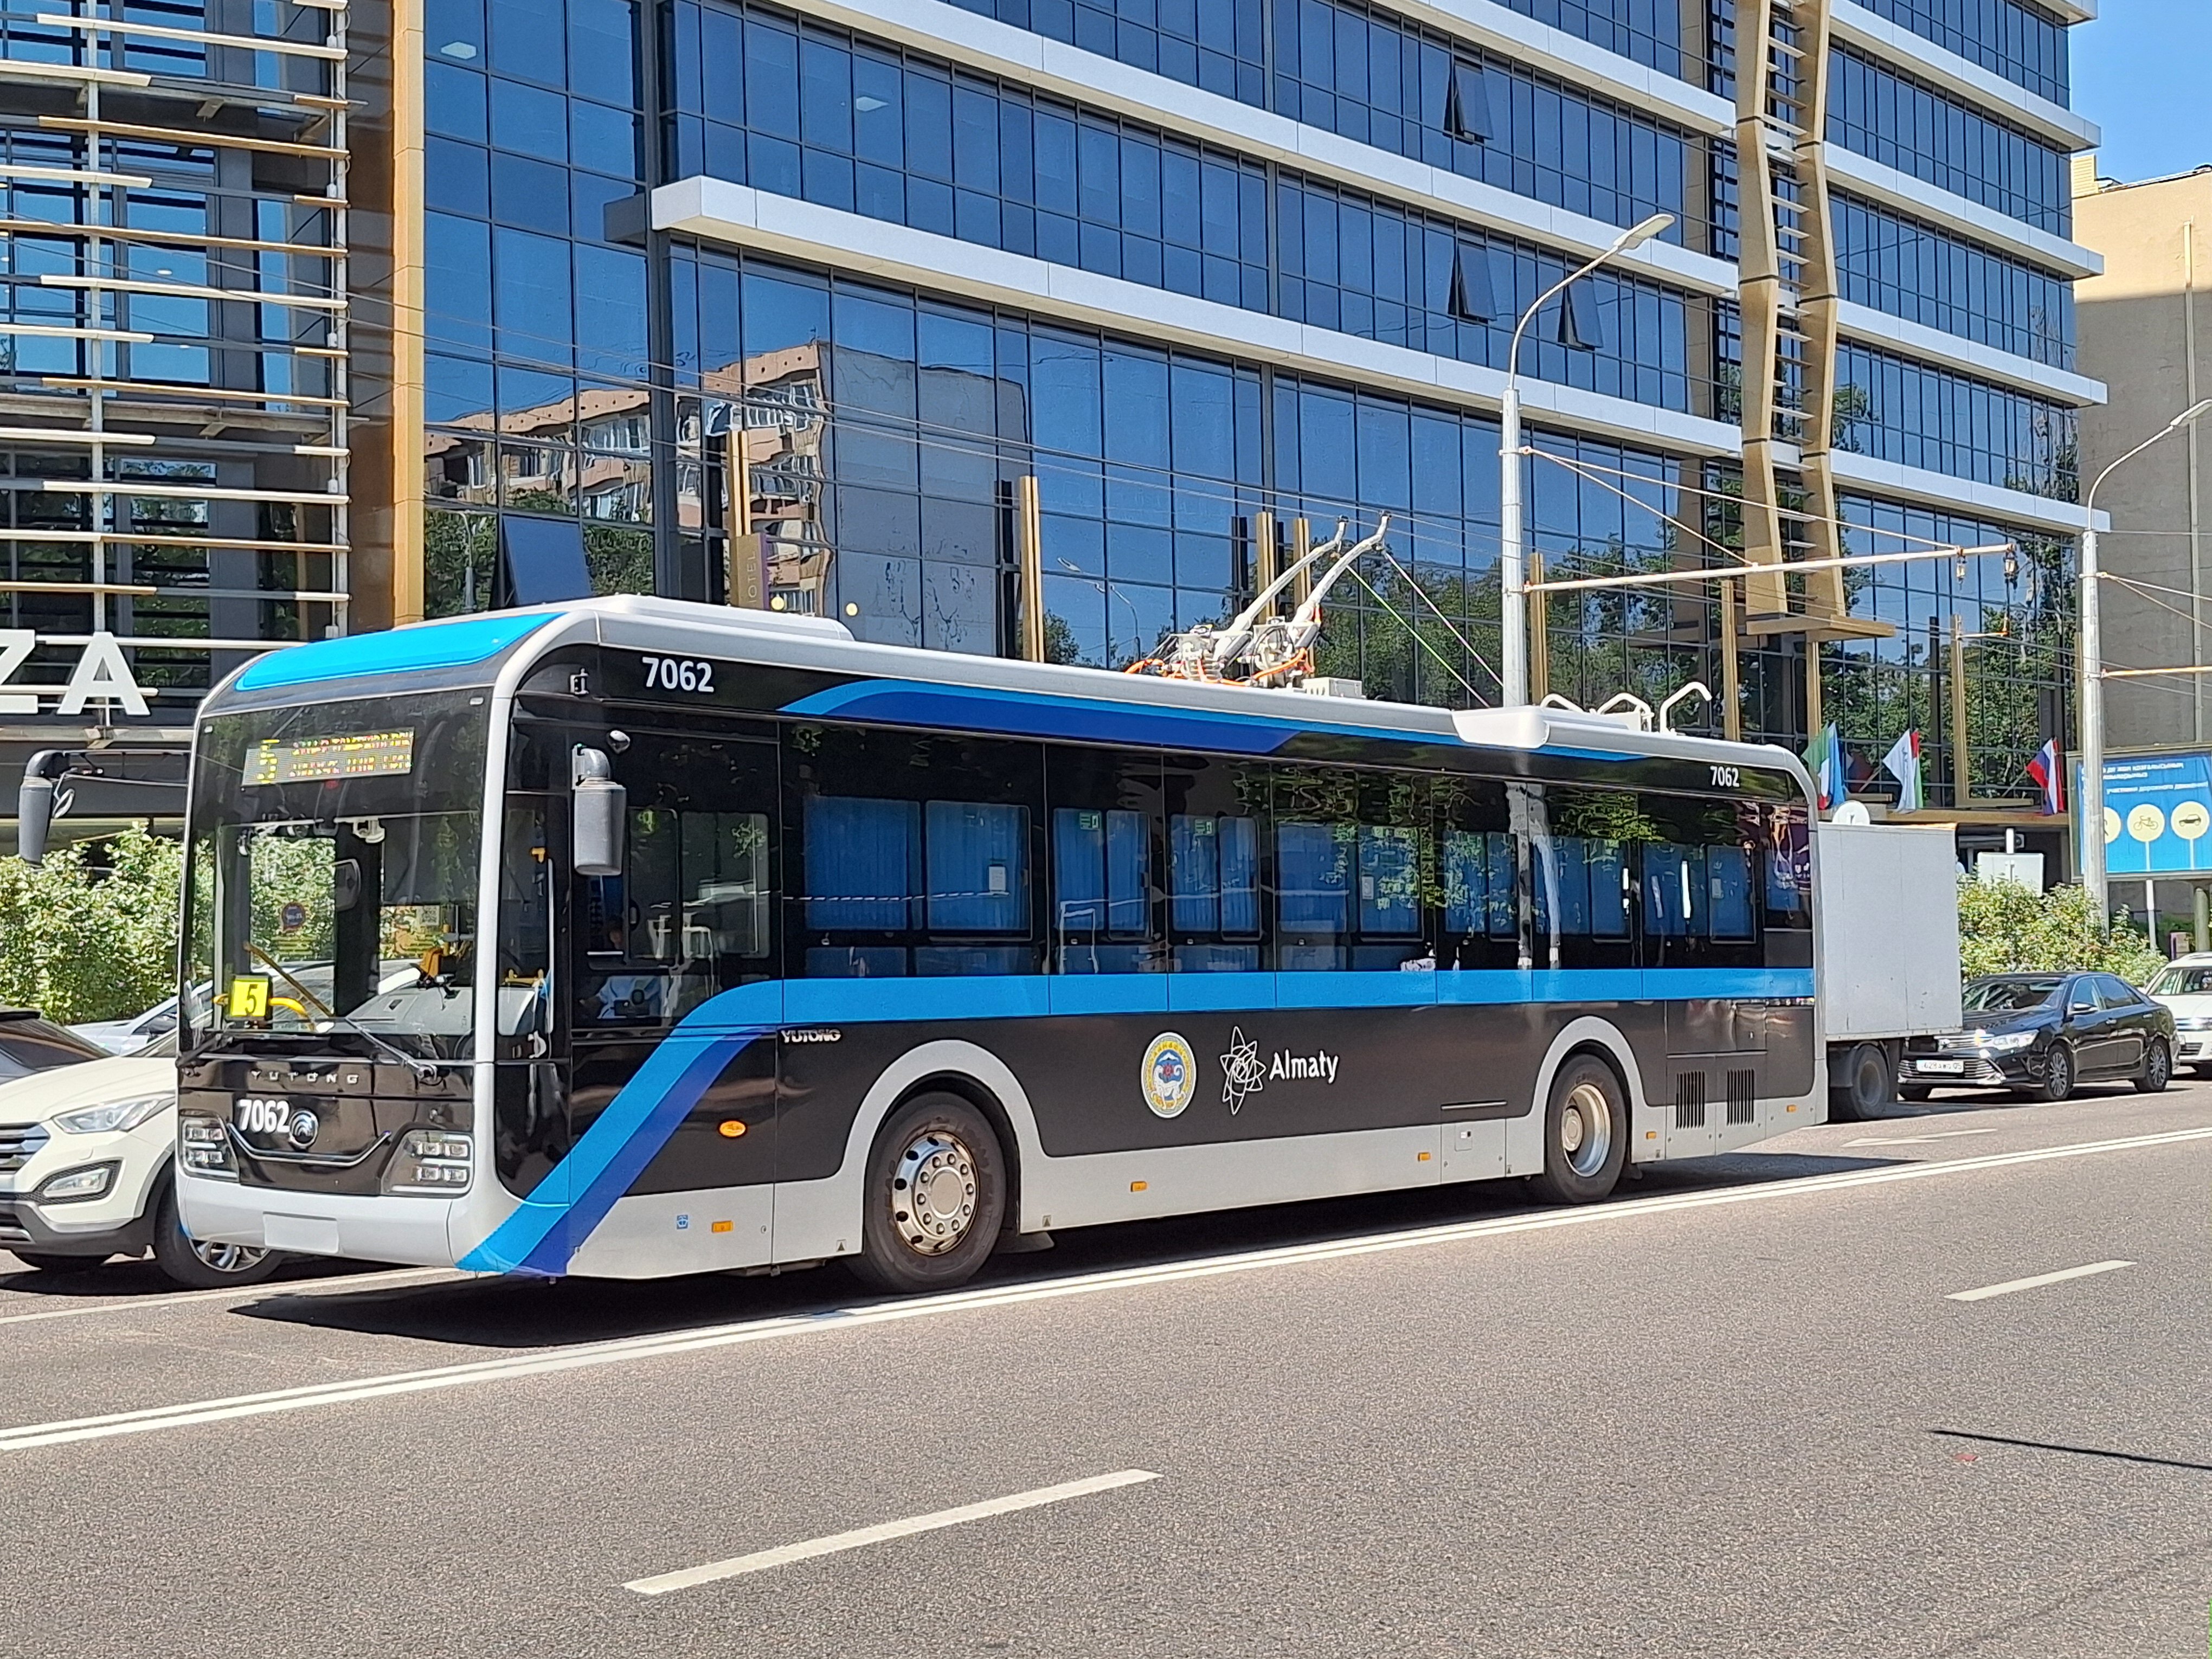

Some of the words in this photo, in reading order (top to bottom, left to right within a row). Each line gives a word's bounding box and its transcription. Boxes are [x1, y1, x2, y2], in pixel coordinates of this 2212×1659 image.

[642, 656, 715, 693] 7062
[255, 738, 281, 785] 5
[1710, 765, 1740, 788] 7062
[244, 984, 258, 1016] 5
[781, 1028, 841, 1043] YUTONG
[250, 1070, 359, 1084] YUTONG
[1269, 1049, 1339, 1084] Almaty
[239, 1099, 291, 1134] 7062
